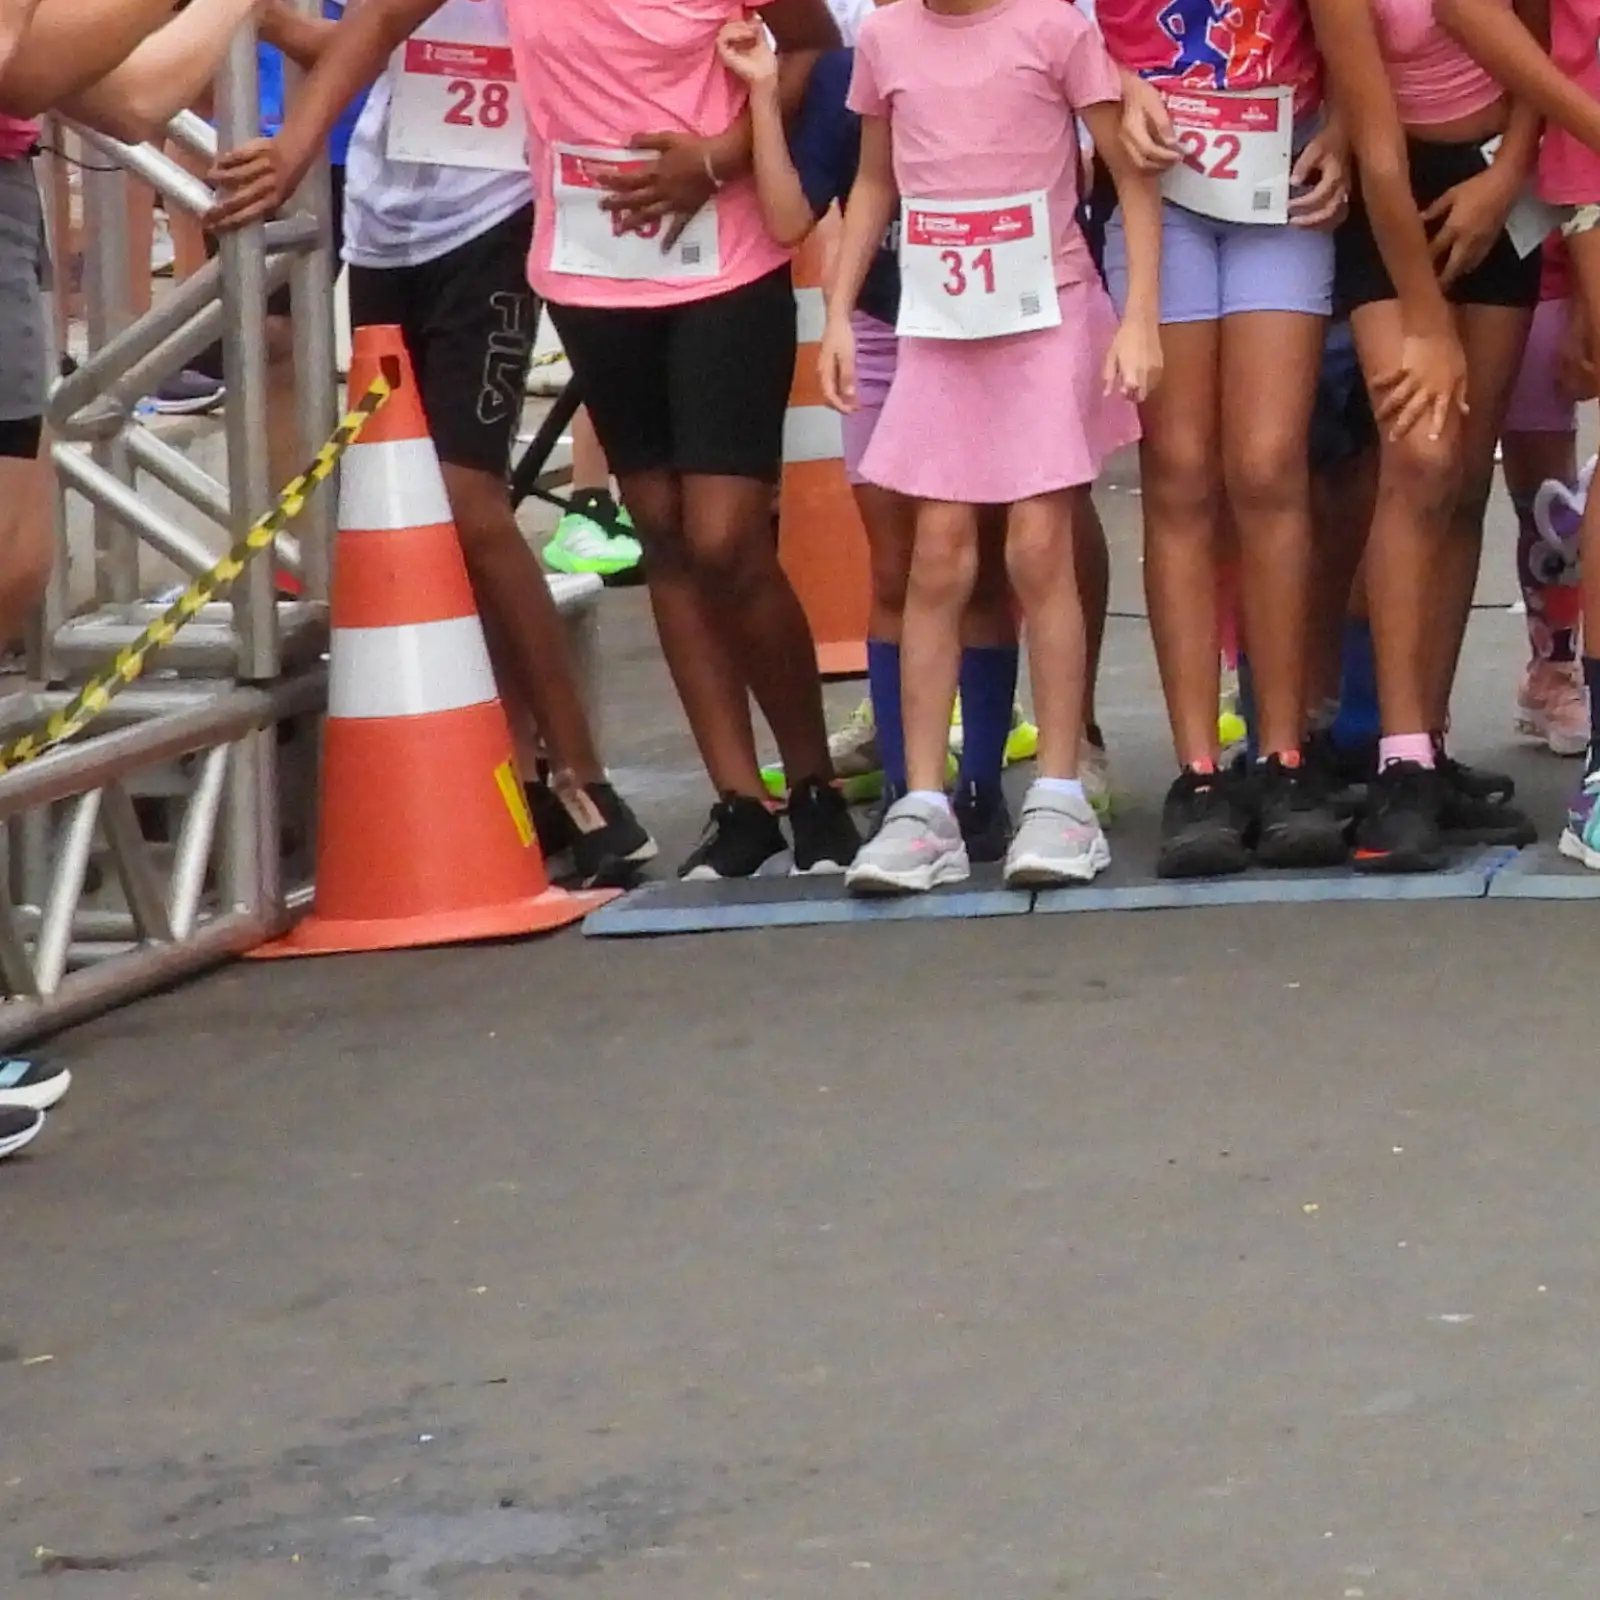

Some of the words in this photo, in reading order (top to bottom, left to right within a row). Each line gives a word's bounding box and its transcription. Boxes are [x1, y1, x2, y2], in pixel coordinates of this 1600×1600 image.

[444, 80, 509, 128] 28
[1178, 130, 1241, 180] 22
[939, 248, 995, 296] 31
